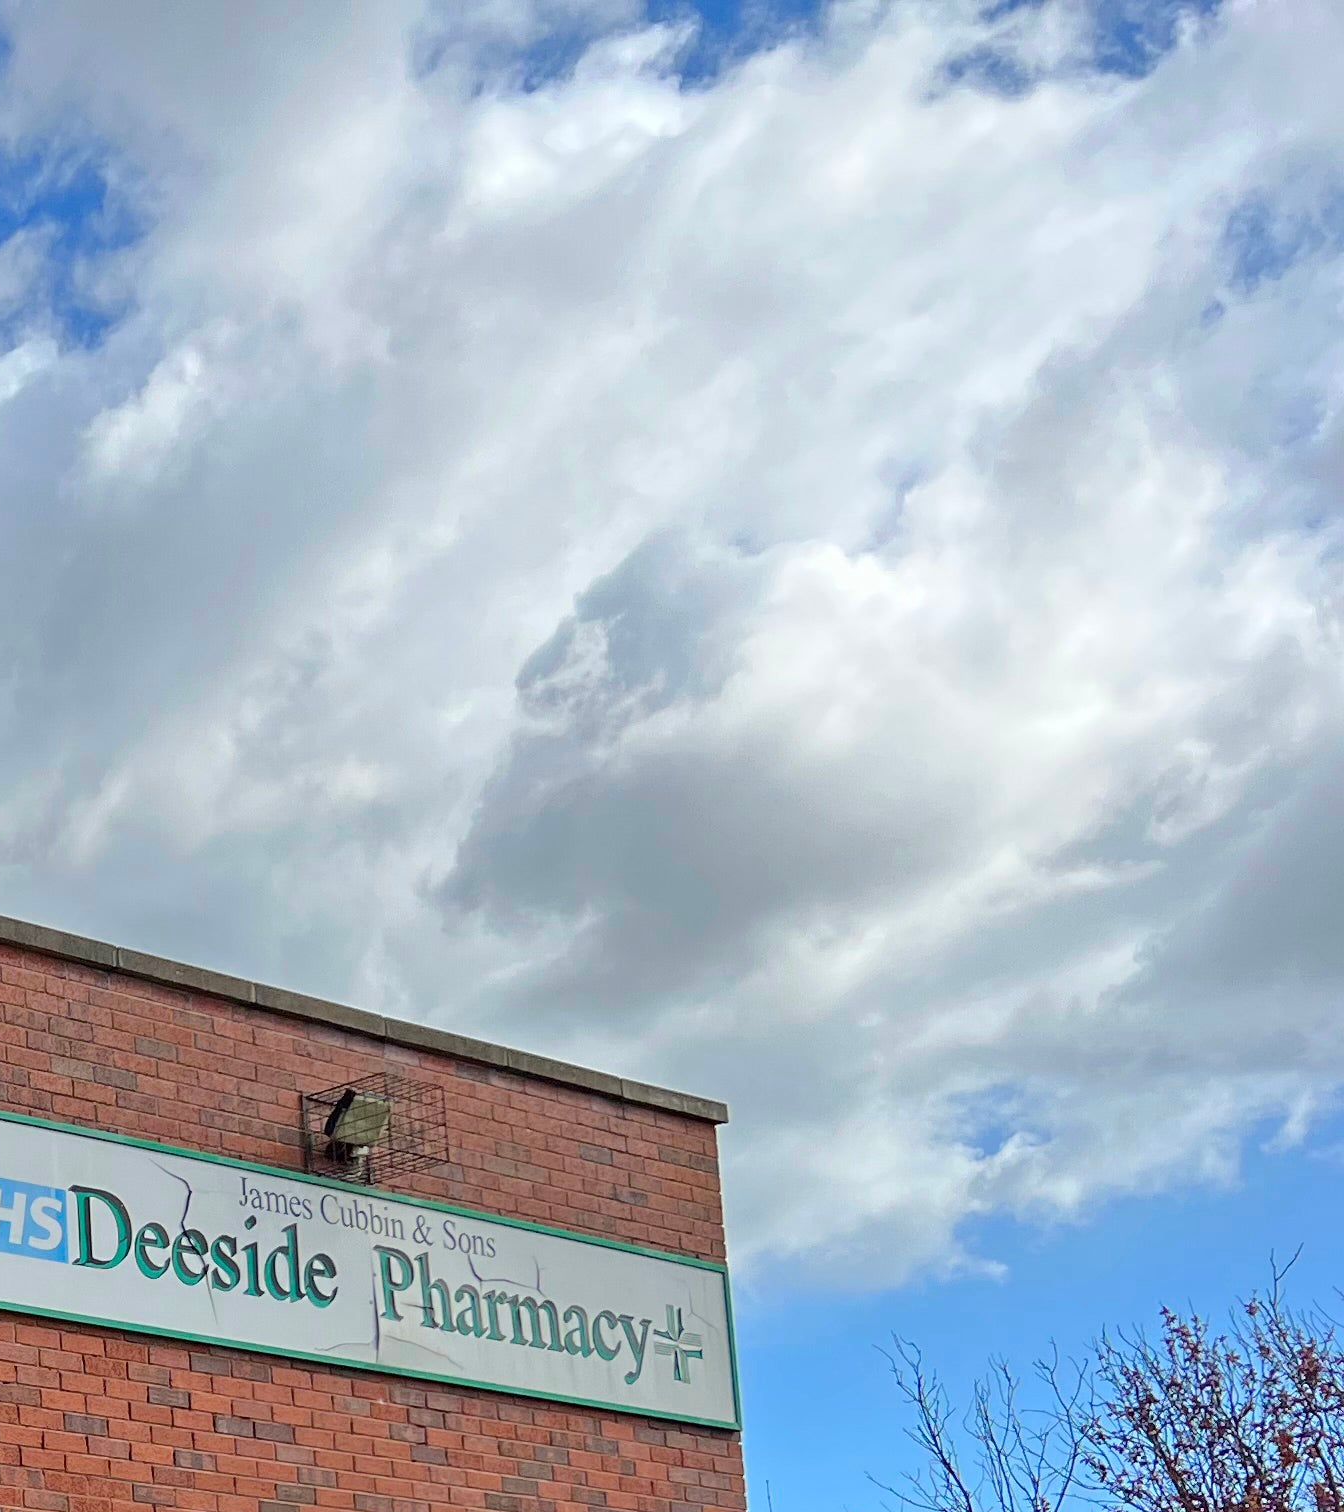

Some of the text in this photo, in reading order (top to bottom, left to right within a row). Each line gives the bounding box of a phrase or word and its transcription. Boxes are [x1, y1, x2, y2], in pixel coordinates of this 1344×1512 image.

[68, 1184, 652, 1385] Deeside Pharmacy
[239, 1176, 496, 1259] James Cubbin & Sons
